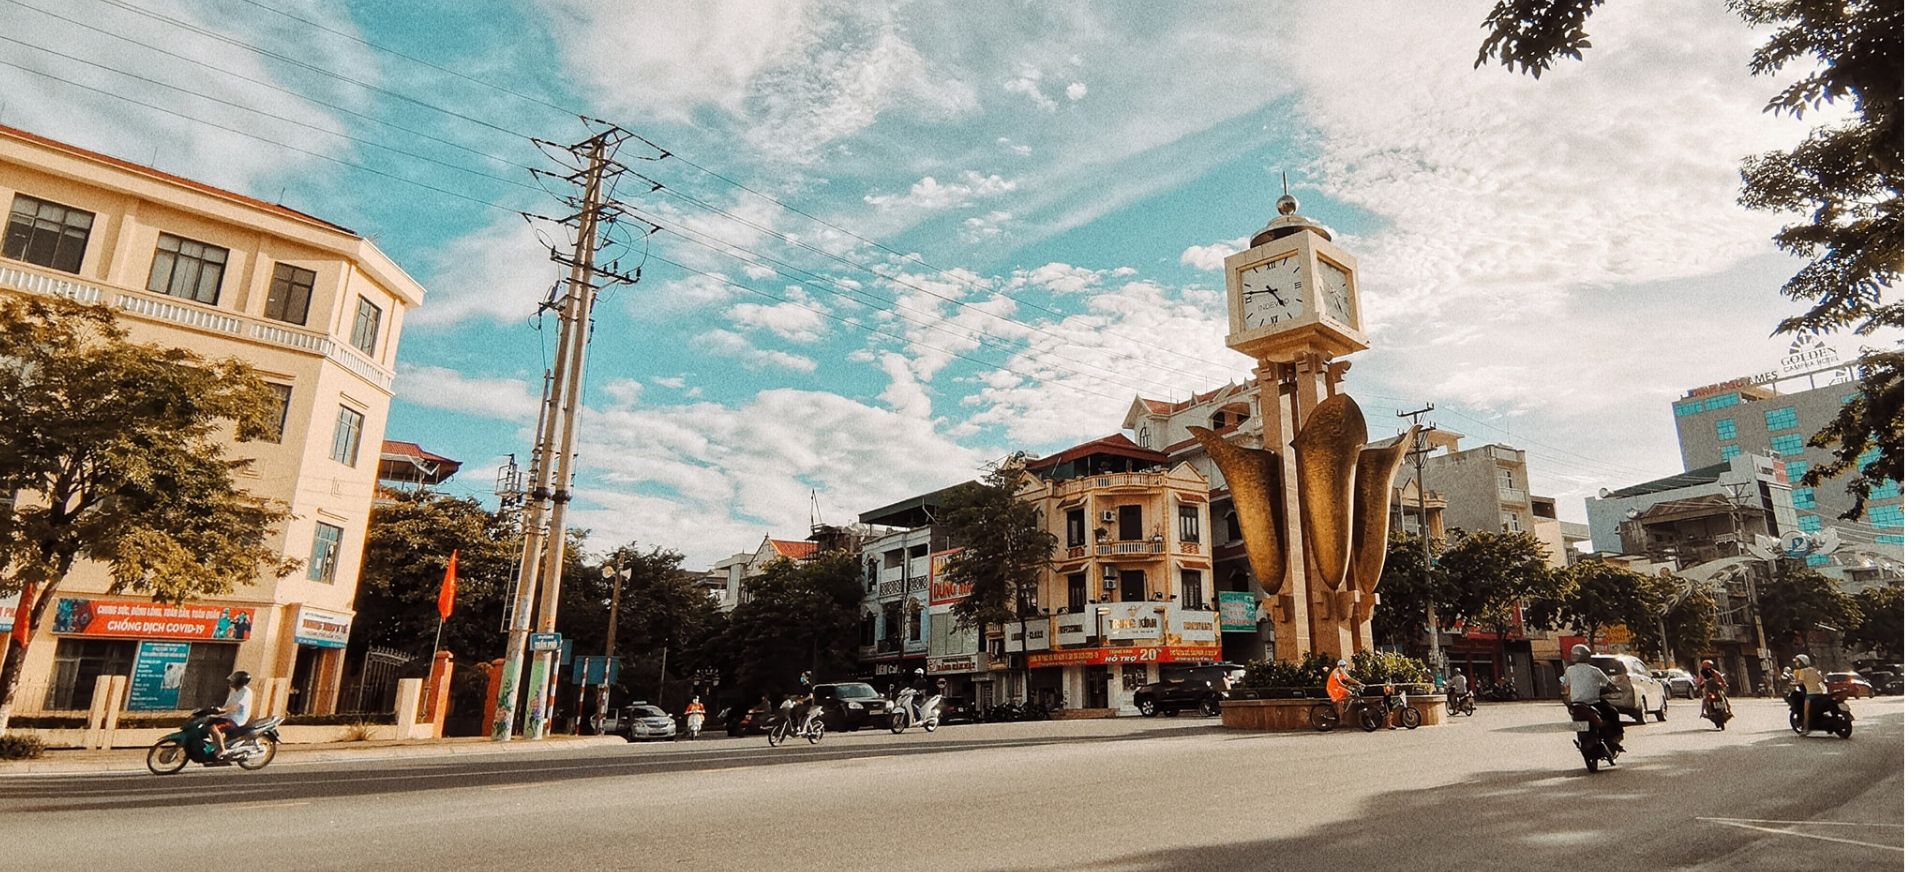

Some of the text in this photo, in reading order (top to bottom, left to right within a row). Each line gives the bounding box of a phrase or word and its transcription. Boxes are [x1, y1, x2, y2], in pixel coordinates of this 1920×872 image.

[1781, 347, 1839, 366] GOLDEN
[107, 616, 205, 634] CHỐNG DỊCH COVID-19
